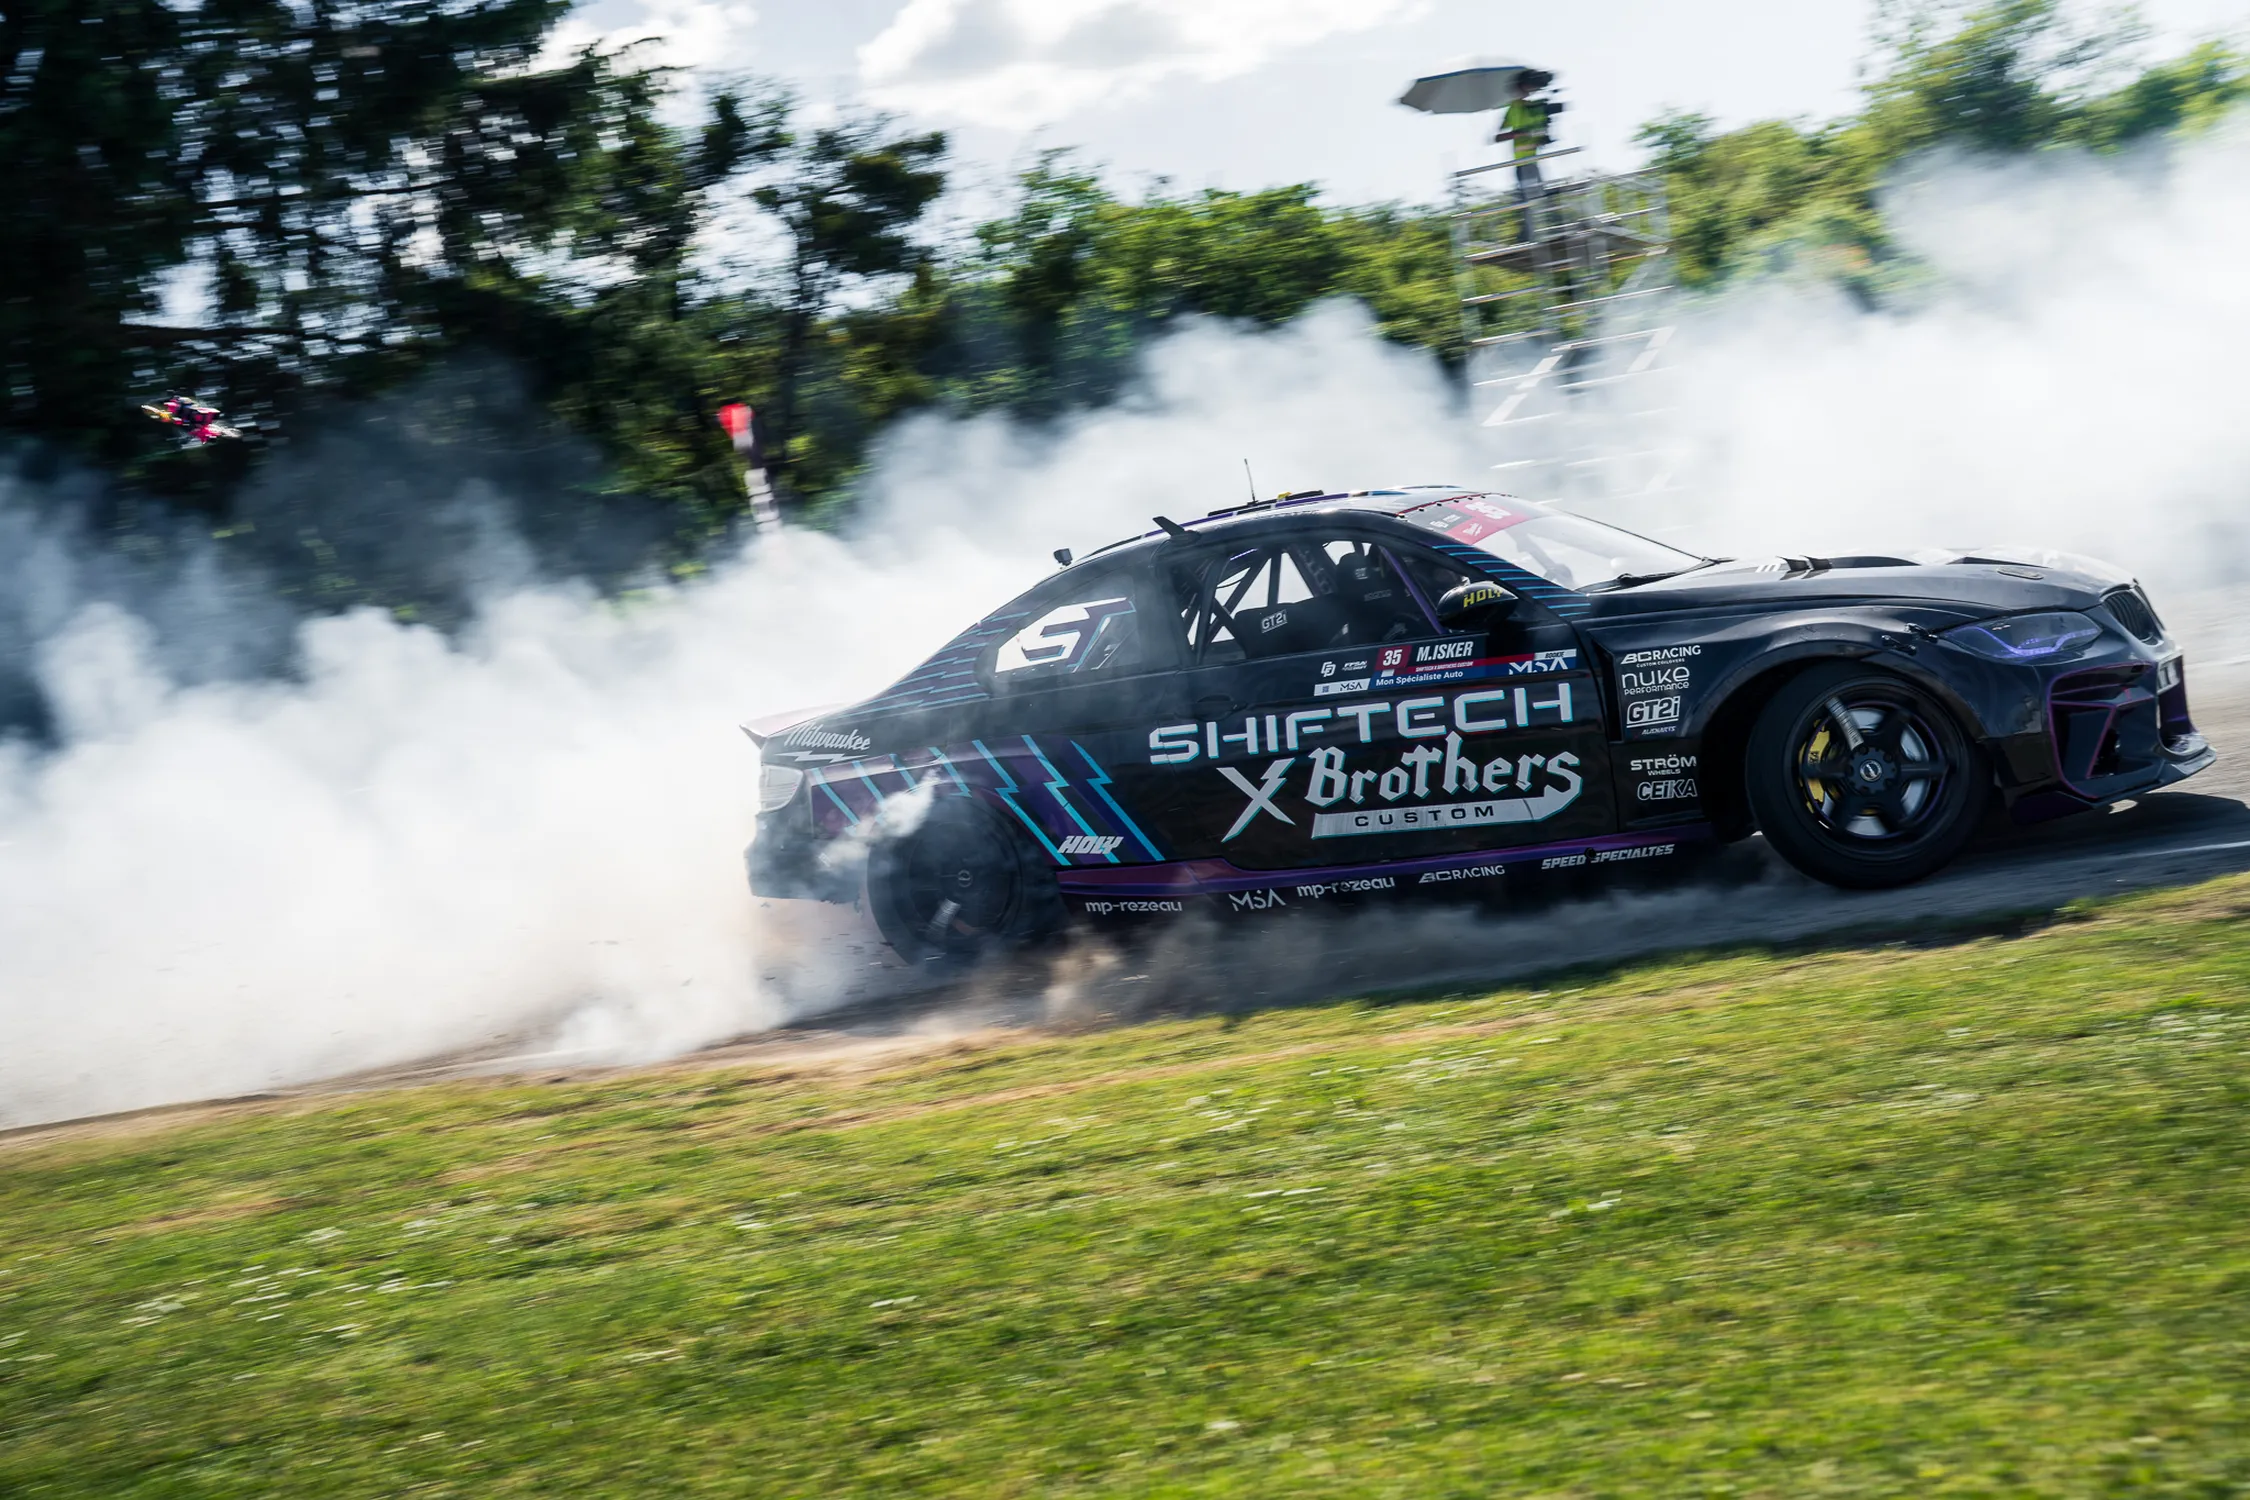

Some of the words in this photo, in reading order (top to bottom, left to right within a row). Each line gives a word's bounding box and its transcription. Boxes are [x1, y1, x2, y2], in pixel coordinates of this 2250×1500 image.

[1463, 588, 1503, 608] HOLY
[1383, 649, 1403, 666] 35
[1416, 641, 1474, 662] M.ISKER
[1376, 678, 1394, 686] Mon
[1396, 673, 1441, 686] Spécialiste
[1443, 671, 1463, 679] Auto
[1149, 683, 1573, 765] SHIFTECH
[784, 721, 871, 751] Milwaukee
[1630, 754, 1697, 771] STRÖM
[1647, 768, 1681, 776] WHEELS
[1304, 731, 1582, 818] Brothers
[1354, 805, 1496, 827] CUSTOM
[1056, 835, 1125, 854] HOLY
[1541, 855, 1587, 870] SPEED
[1296, 876, 1396, 899] mp-rezeau
[1085, 901, 1183, 915] mp-rezeau
